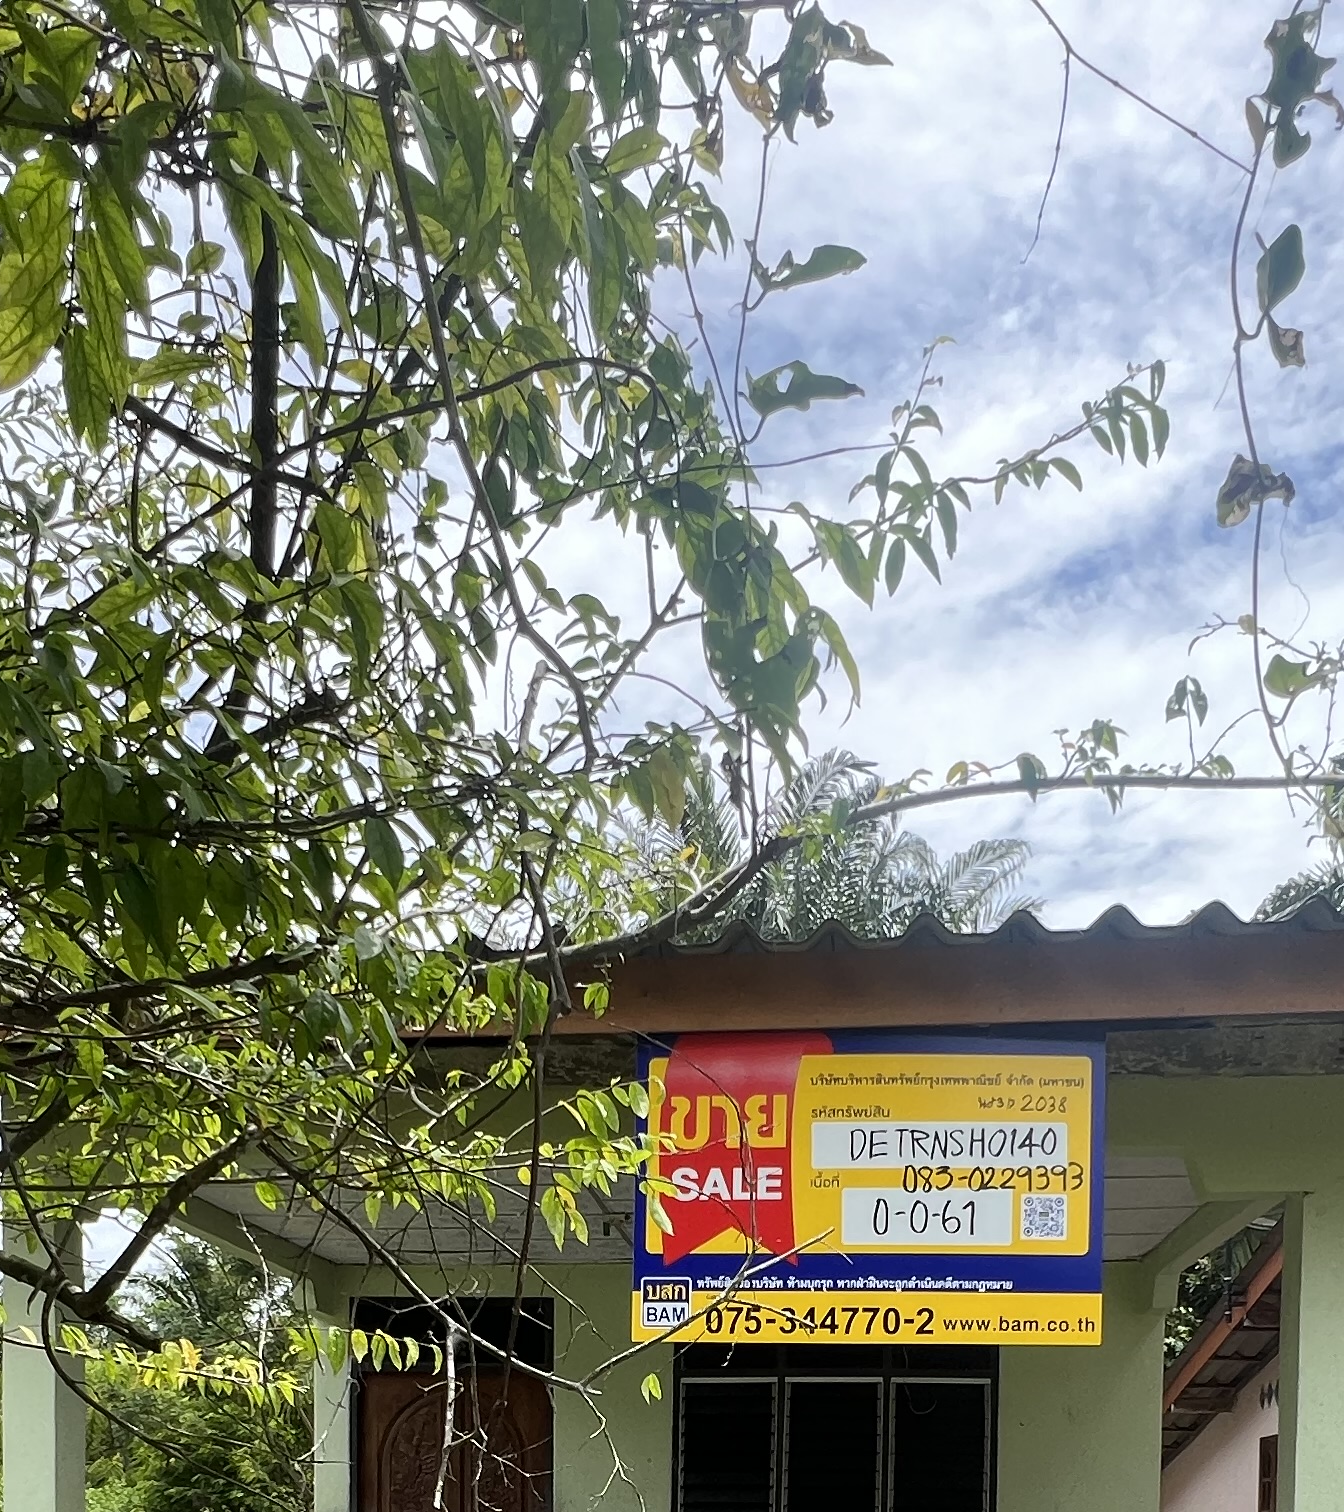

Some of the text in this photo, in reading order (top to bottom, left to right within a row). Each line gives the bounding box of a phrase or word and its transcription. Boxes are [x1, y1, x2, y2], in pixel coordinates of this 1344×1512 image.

[810, 1072, 1085, 1090] บริษัทบริหารสินทรัพย์กรุงเทพพาณิชย์ จำกัด (มหาชน)
[810, 1105, 891, 1119] รหัสทรัพย์สิน
[1020, 1094, 1068, 1114] 2038
[670, 1094, 788, 1150] ขาย
[671, 1167, 783, 1202] SALE
[809, 1171, 840, 1189] เนื้อที่
[902, 1162, 1084, 1194] 083-0229393
[872, 1198, 976, 1236] 0-0-61
[646, 1282, 687, 1300] บสก
[696, 1275, 784, 1289] ทรัพย์สิของบริษัท
[786, 1275, 834, 1292] ห้ามบุกรุก
[646, 1306, 686, 1323] BAM
[705, 1306, 1096, 1336] 075-344770-2 www.bam.co.th
